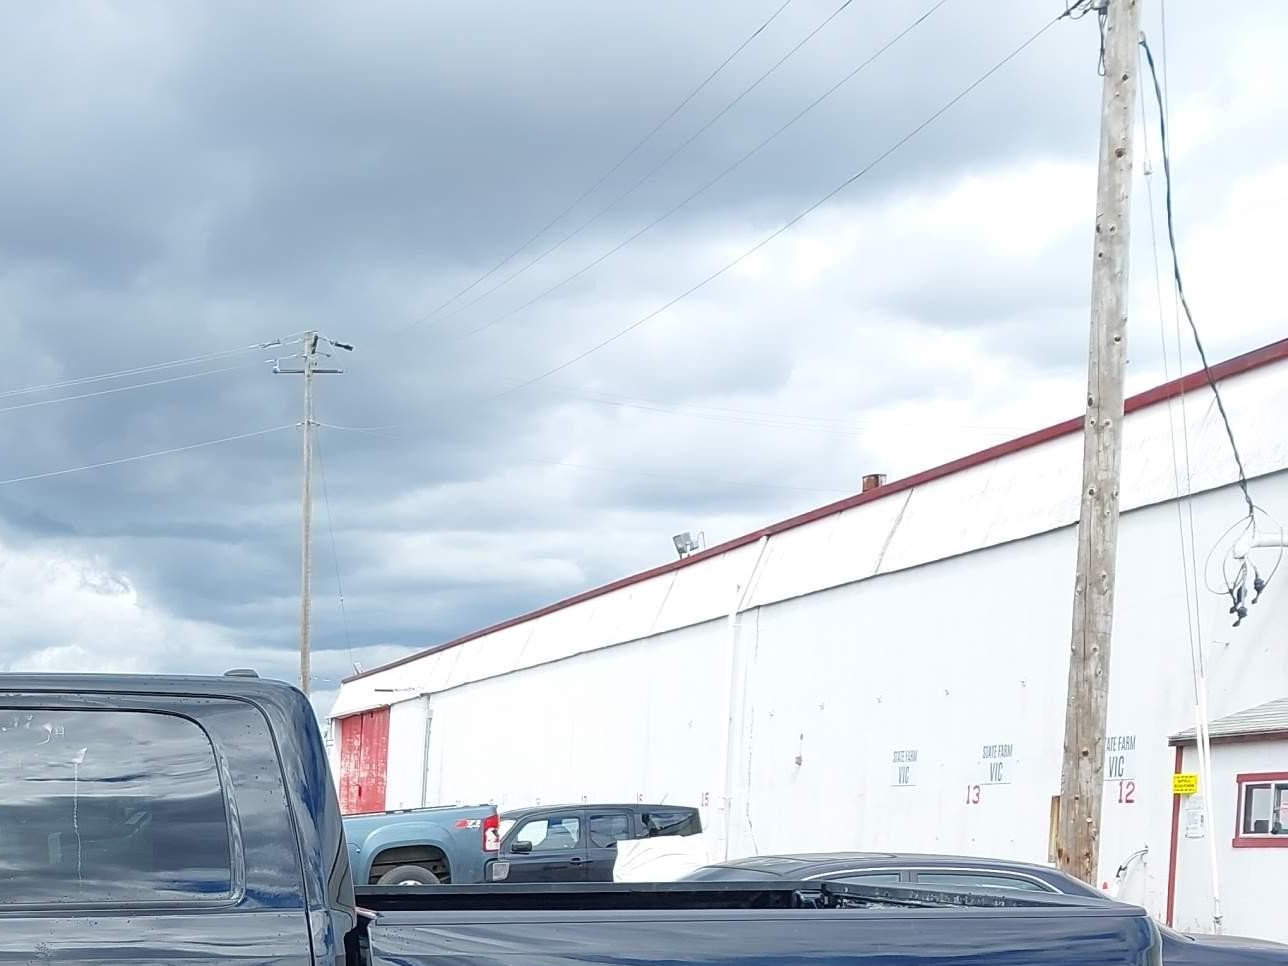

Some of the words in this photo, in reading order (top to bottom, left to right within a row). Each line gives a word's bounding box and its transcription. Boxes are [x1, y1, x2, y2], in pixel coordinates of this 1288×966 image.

[982, 745, 998, 759] STATE
[998, 744, 1014, 758] FARM
[1118, 736, 1136, 751] FARM
[893, 750, 905, 763] STATE
[906, 749, 918, 762] FARM
[898, 766, 910, 784] VIC
[990, 762, 1004, 782] VIC
[1108, 755, 1125, 778] VIC
[966, 784, 981, 804] 13
[1118, 781, 1136, 803] 12
